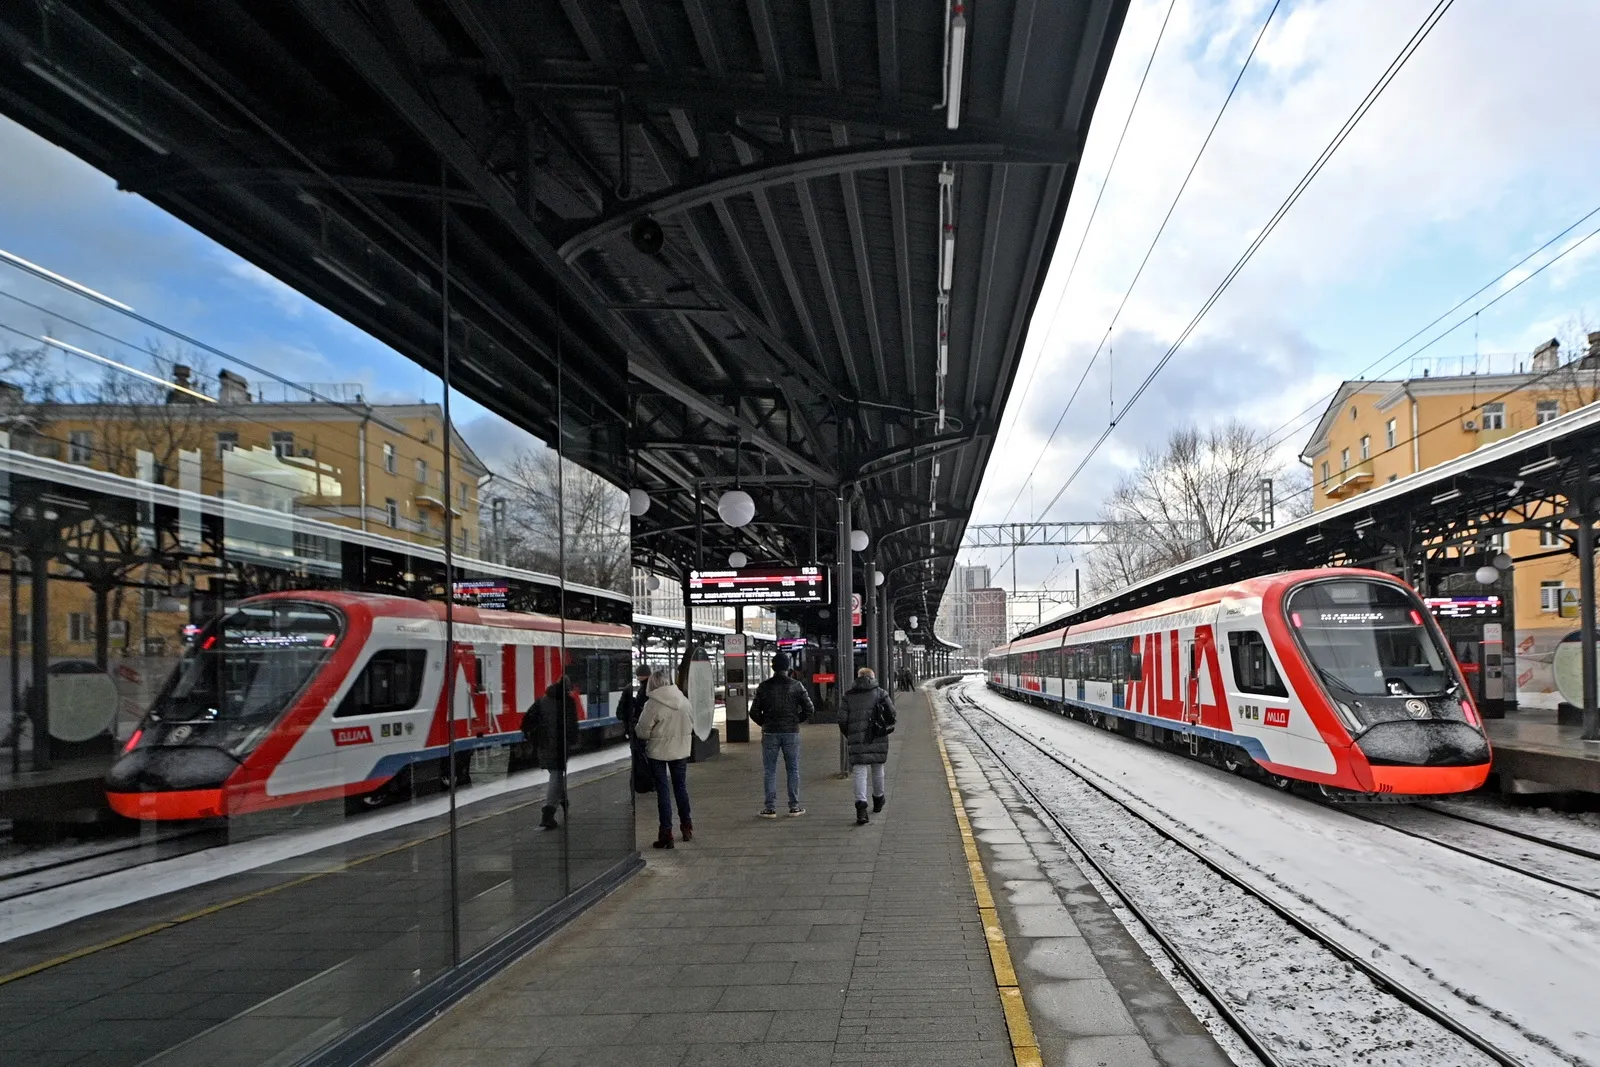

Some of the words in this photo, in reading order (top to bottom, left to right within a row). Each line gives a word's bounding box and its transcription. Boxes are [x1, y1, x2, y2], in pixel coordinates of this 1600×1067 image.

[727, 637, 742, 646] SOS
[1126, 624, 1233, 731] МЦД
[1266, 711, 1286, 724] МЦД
